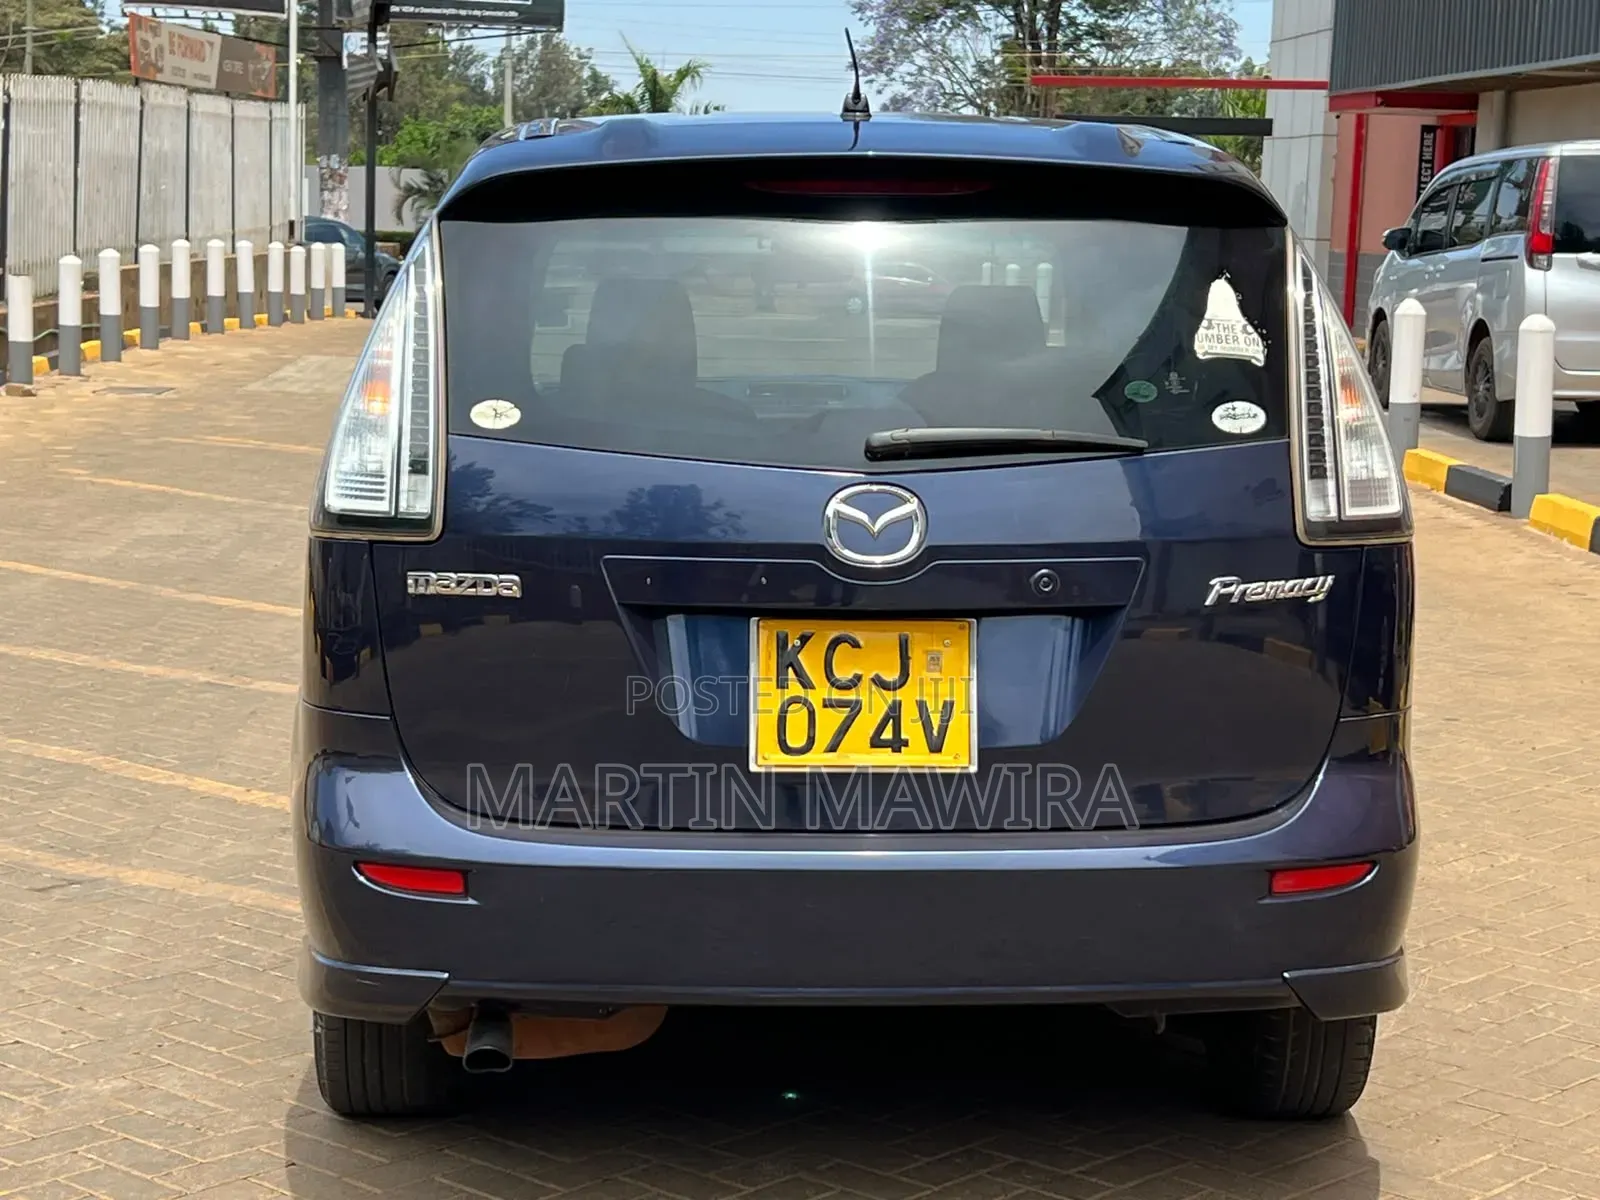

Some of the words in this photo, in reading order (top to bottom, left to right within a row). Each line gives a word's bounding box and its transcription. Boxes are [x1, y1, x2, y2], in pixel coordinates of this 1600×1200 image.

[1422, 131, 1434, 161] HERE
[1214, 322, 1237, 335] THE
[1203, 574, 1336, 607] Premacy
[775, 629, 911, 692] KCJ
[776, 695, 956, 757] 074V
